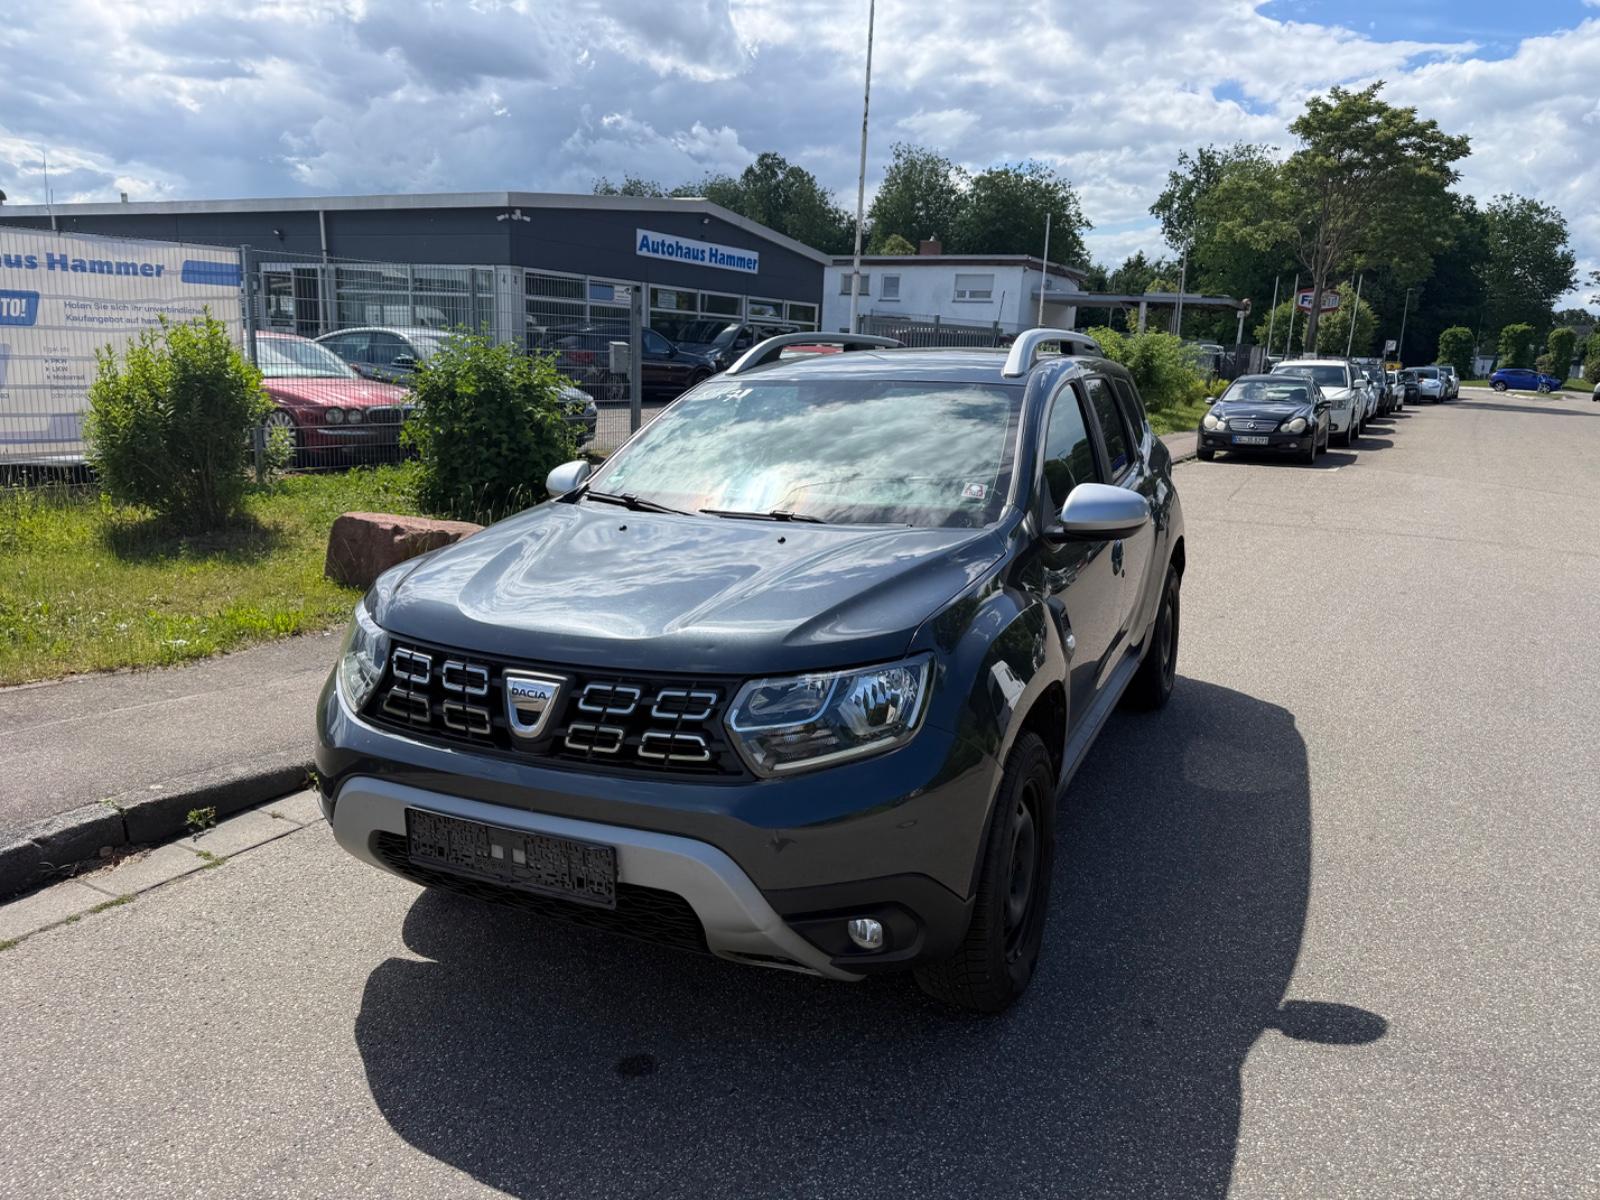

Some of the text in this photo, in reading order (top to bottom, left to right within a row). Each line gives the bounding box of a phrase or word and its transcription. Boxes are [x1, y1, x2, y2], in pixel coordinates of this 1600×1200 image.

[638, 234, 758, 271] Autohaus Hammer
[0, 252, 165, 277] us Hammer
[94, 302, 109, 310] Sie
[110, 304, 129, 312] sich
[145, 305, 206, 315] unverbindliche
[65, 314, 124, 324] Kaufangebot
[511, 687, 547, 700] DACIA
